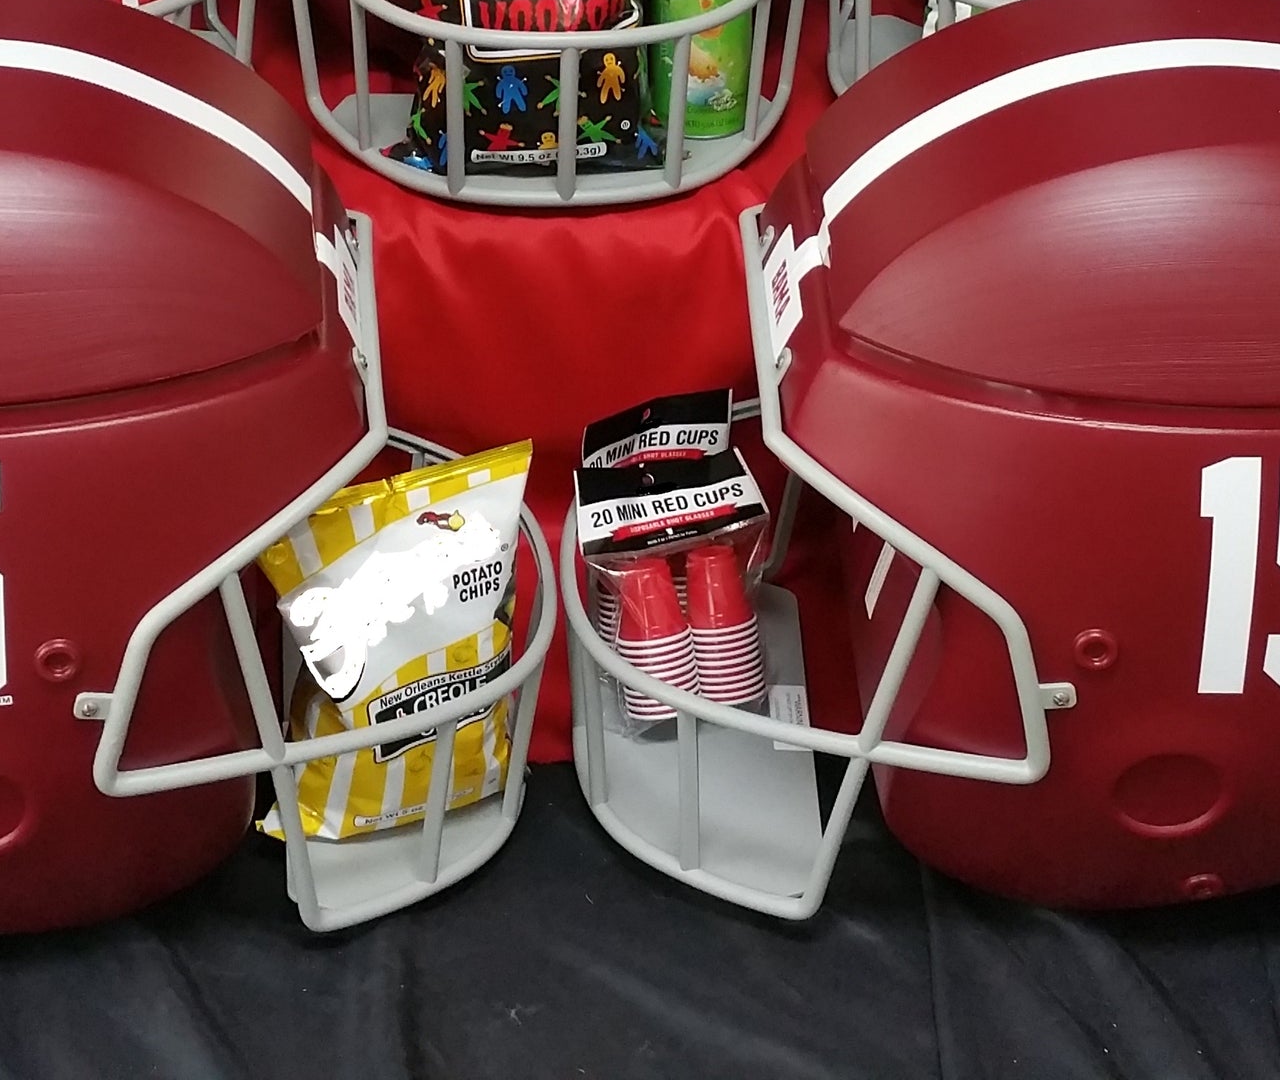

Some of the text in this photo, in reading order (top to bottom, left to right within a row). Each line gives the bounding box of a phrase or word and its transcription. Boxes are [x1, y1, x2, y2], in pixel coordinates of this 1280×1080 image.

[606, 439, 635, 465] MINI
[639, 431, 670, 449] RED
[676, 429, 719, 446] CUPS
[591, 483, 744, 528] 20 MINI RED CUPS
[453, 561, 502, 589] POTATO
[460, 577, 499, 602] CHIPS
[379, 694, 402, 709] New
[405, 677, 446, 697] Orleans
[449, 669, 482, 681] Kettle
